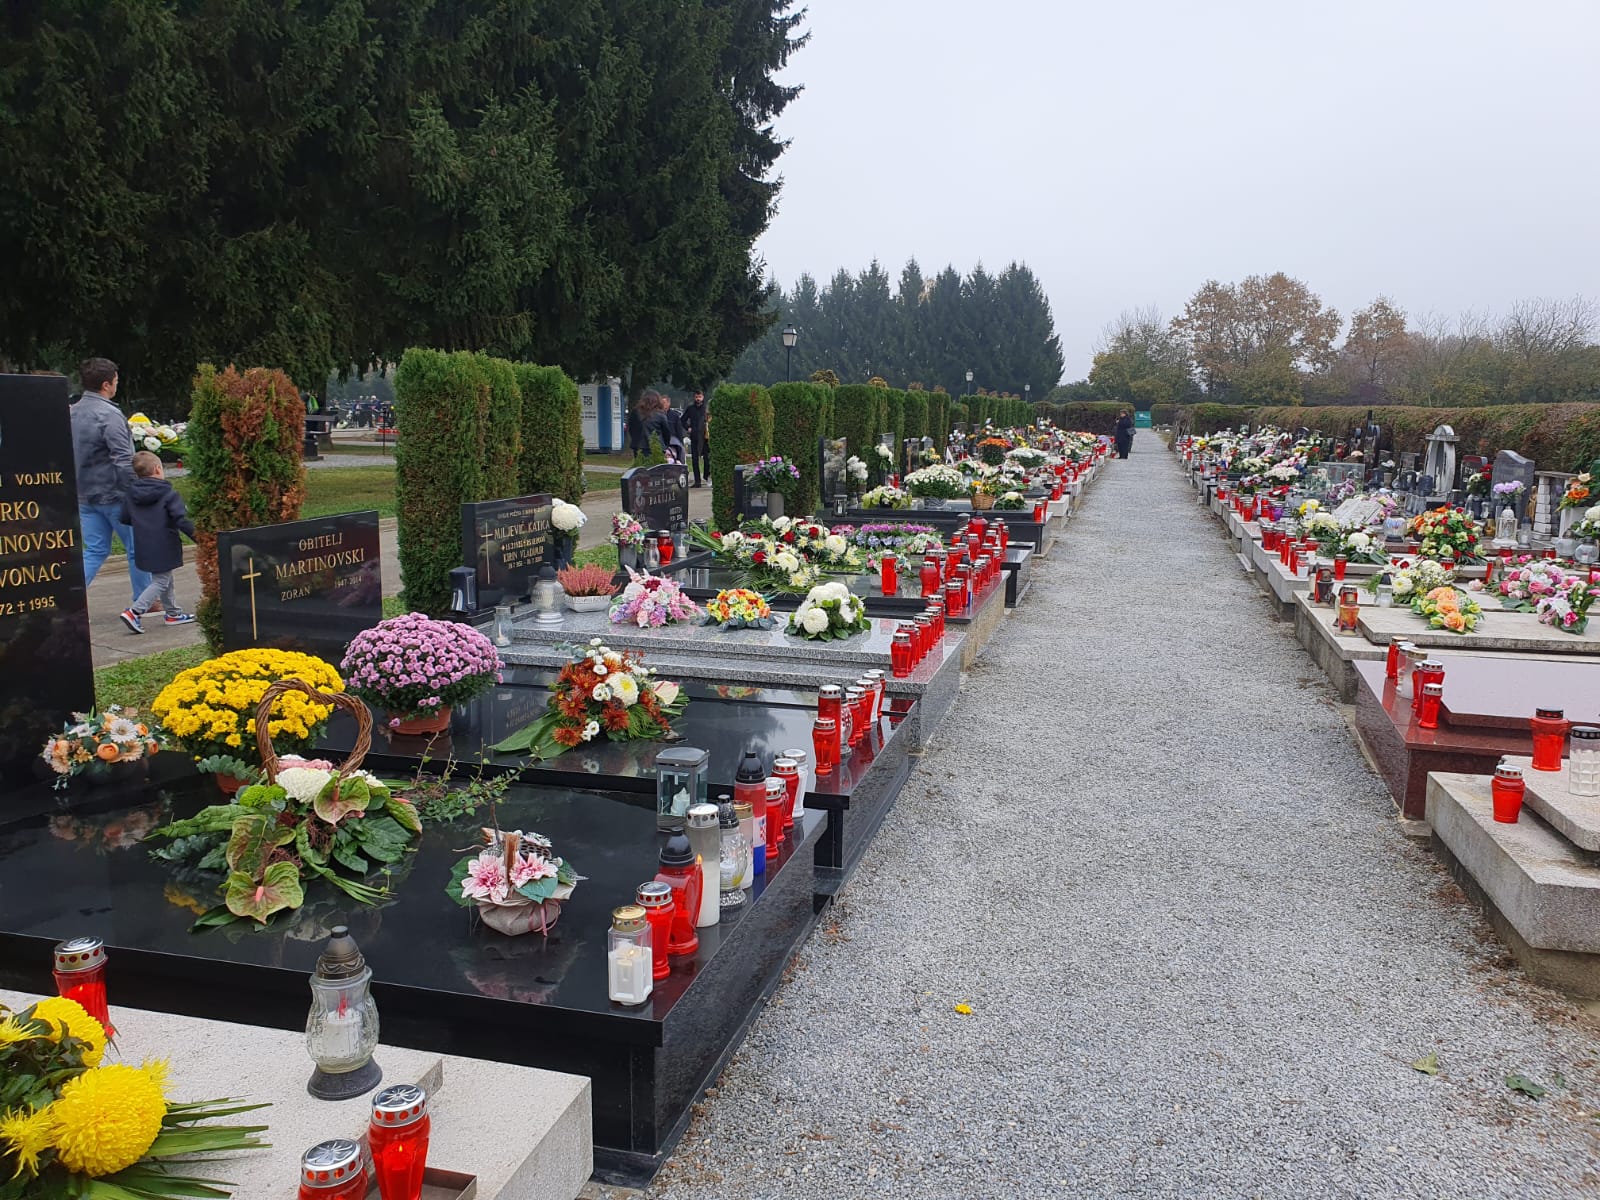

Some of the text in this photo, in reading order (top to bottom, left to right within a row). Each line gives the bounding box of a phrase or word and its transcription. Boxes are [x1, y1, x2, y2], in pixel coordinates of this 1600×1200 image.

[15, 472, 64, 486] VOJNIK
[298, 532, 343, 552] OBITELJ
[275, 547, 365, 580] MARTINOVSKI
[281, 586, 312, 602] ZORAN
